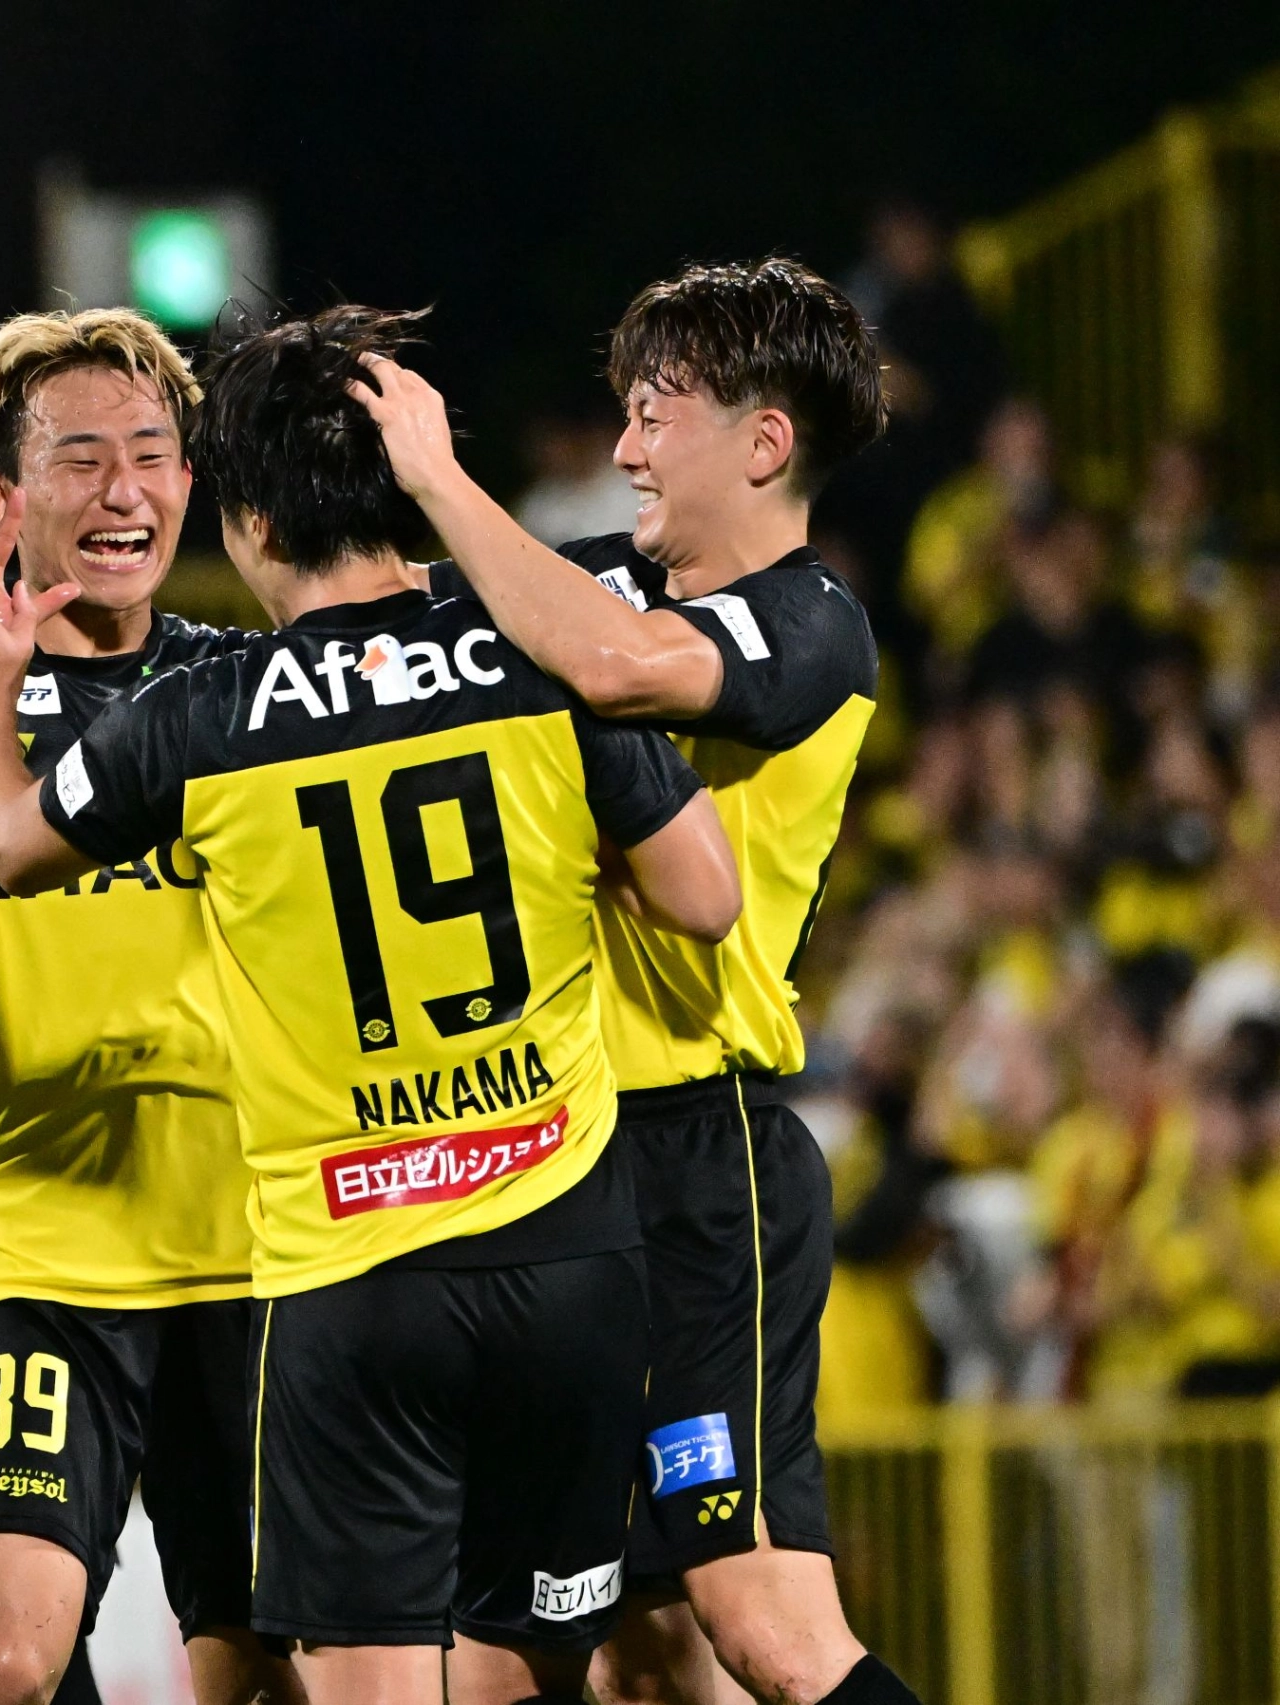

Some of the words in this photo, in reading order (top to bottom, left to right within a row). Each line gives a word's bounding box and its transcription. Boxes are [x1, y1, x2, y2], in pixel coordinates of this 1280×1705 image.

[247, 628, 505, 731] Aflac
[295, 751, 531, 1053] 19
[351, 1042, 554, 1130] NAKAMA
